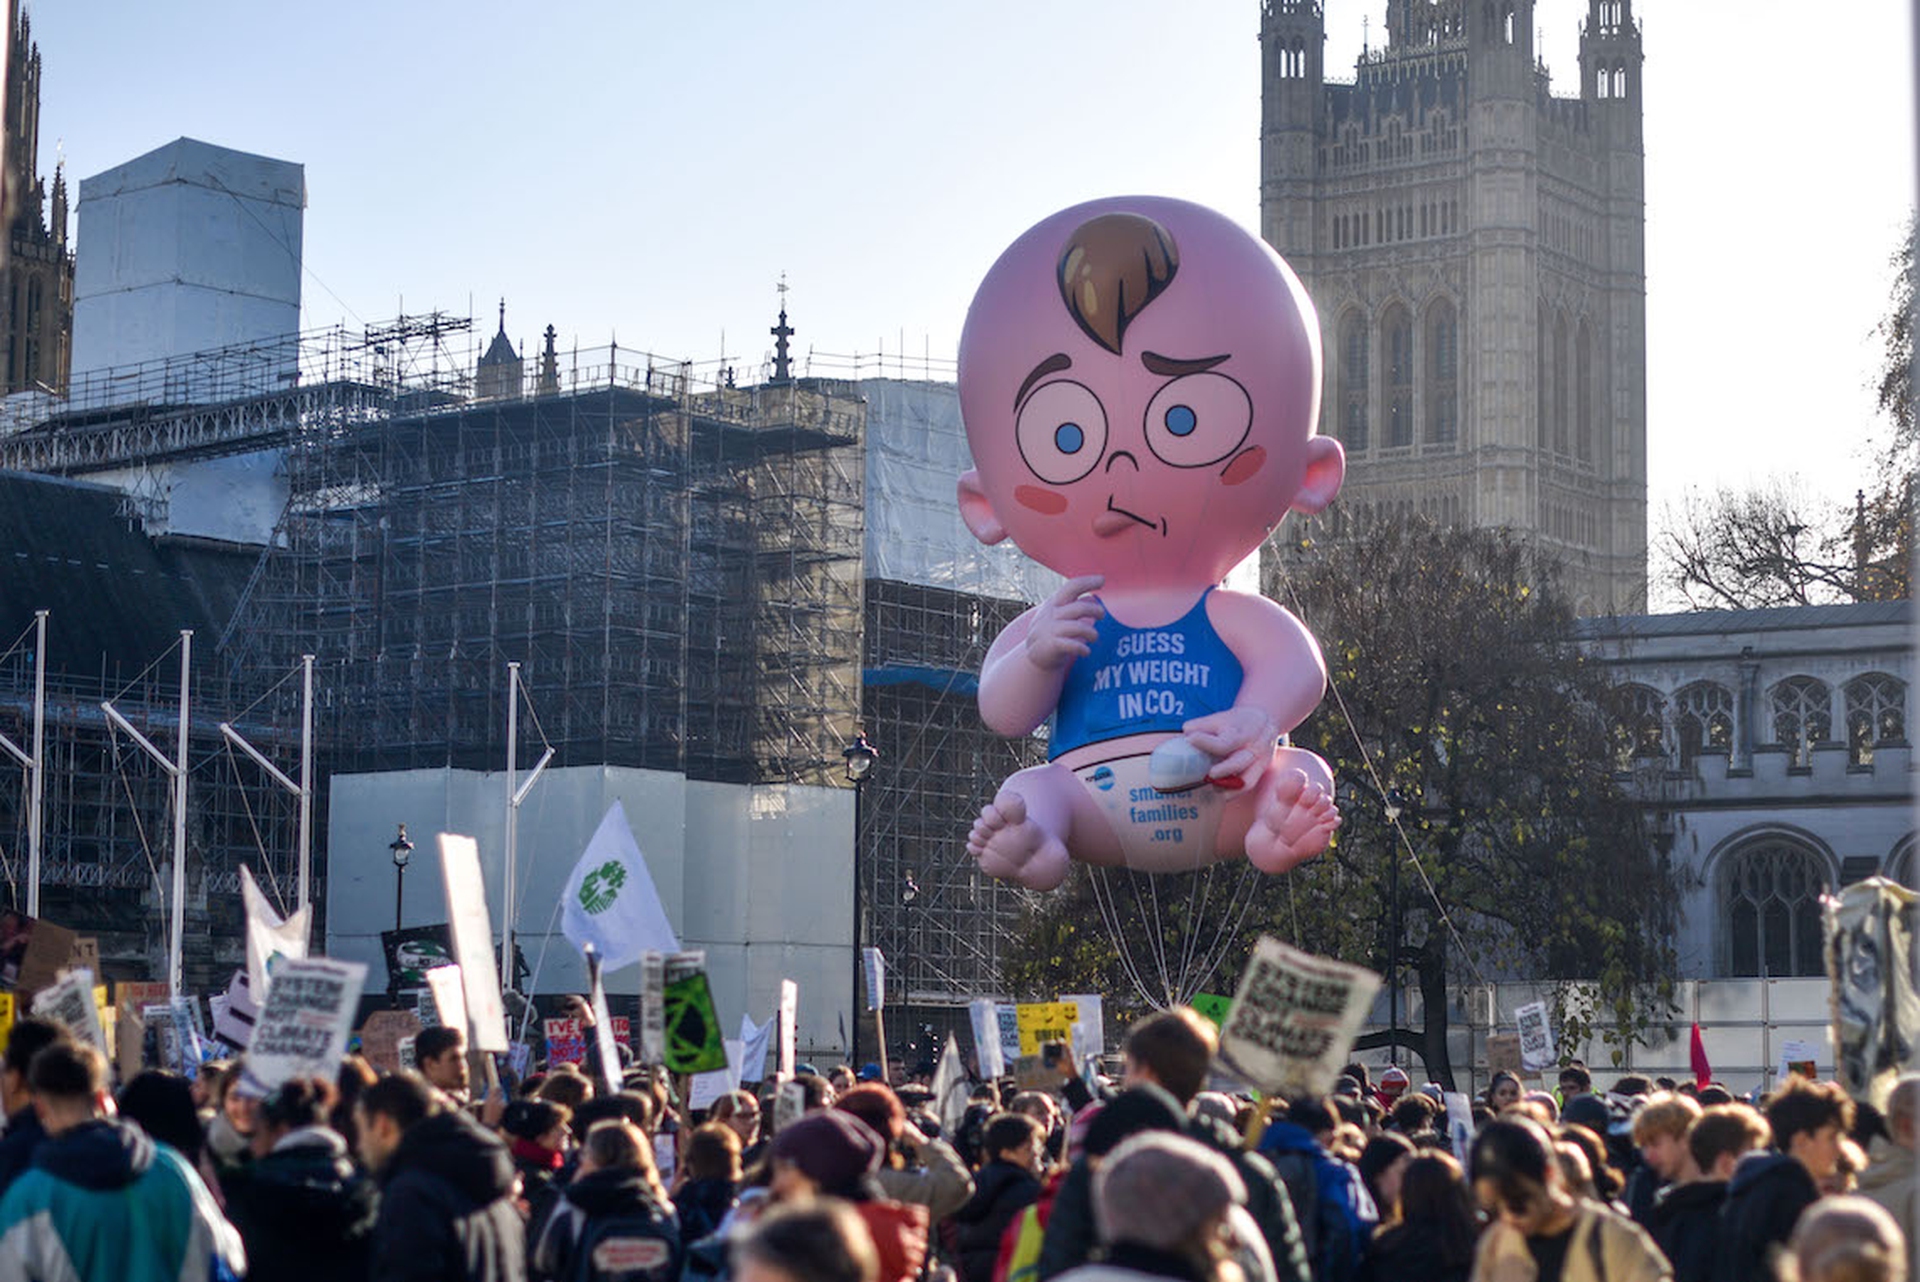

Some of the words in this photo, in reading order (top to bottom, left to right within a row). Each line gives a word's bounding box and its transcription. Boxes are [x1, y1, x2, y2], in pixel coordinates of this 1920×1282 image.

[1117, 631, 1185, 658] GUESS
[1093, 662, 1124, 692] MY
[1127, 659, 1210, 688] WEIGHT
[1118, 692, 1144, 720] IN
[1130, 804, 1198, 823] families
[1150, 828, 1184, 843] .org
[258, 1024, 334, 1047] CLIMATE
[548, 1019, 574, 1034] I'VE
